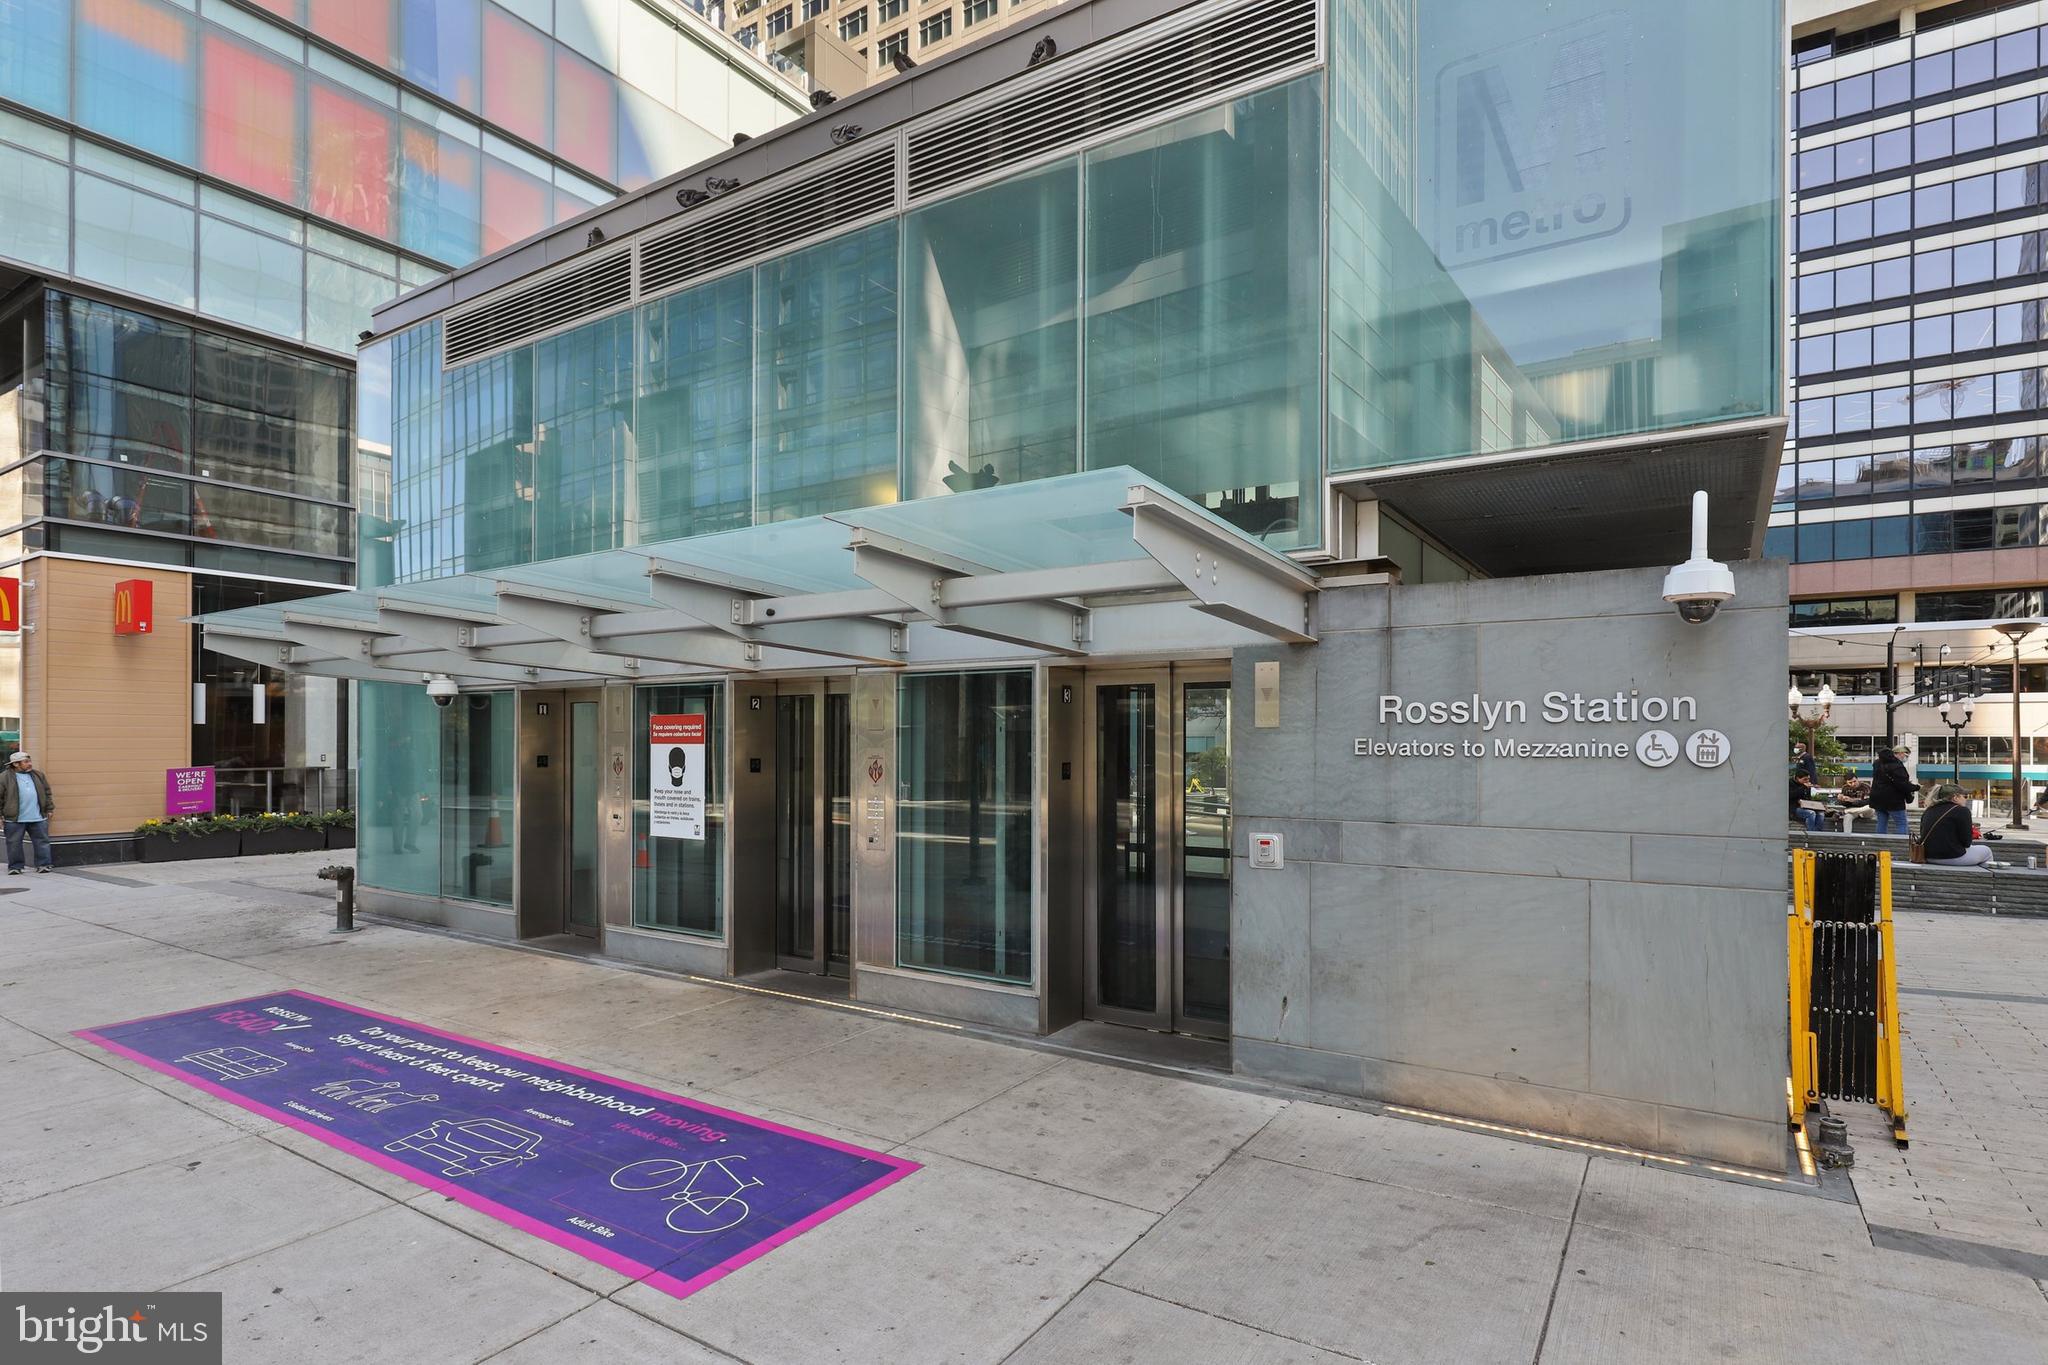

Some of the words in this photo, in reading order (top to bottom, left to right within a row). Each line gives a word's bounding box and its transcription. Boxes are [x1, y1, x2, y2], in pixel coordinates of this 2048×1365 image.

[1455, 193, 1606, 253] metro
[1378, 693, 1527, 732] Rosslyn
[1541, 690, 1698, 724] Station
[1354, 738, 1455, 758] Elevators
[1462, 739, 1486, 758] to
[1494, 738, 1629, 758] Mezzanine
[175, 771, 207, 779] WE'RE
[177, 778, 205, 786] OPEN
[262, 1006, 312, 1022] ROSSLYN
[360, 1026, 385, 1036] Do
[371, 1032, 417, 1046] your
[329, 1033, 366, 1047] Stay
[357, 1042, 384, 1053] at
[373, 1047, 416, 1063] least
[408, 1058, 431, 1067] 6
[420, 1062, 461, 1077] feet
[401, 1042, 449, 1057] part
[441, 1050, 464, 1060] to
[457, 1054, 500, 1072] keep
[494, 1067, 529, 1079] our
[523, 1076, 656, 1117] neighborhood
[645, 1111, 727, 1142] moving.
[565, 1216, 596, 1230] Adult
[591, 1225, 616, 1238] Bike
